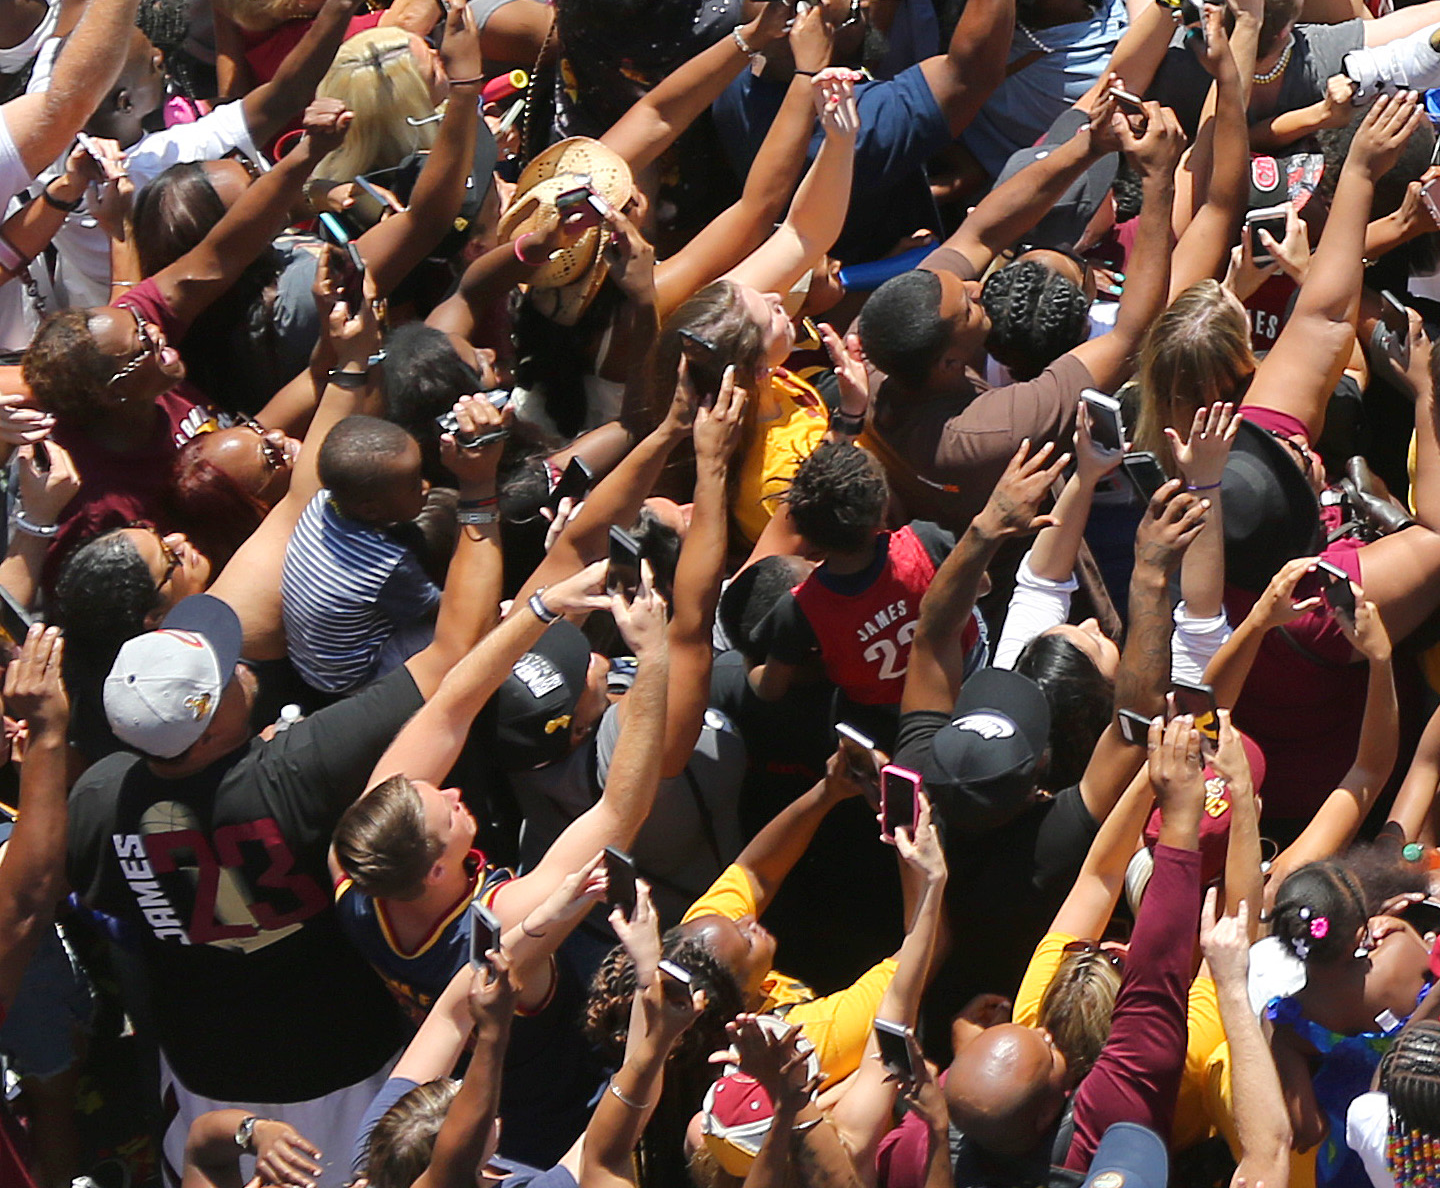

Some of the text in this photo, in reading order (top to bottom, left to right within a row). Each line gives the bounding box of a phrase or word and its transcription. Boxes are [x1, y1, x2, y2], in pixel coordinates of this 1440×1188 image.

[856, 598, 908, 643] JAMES
[112, 833, 191, 947] JAMES
[141, 816, 329, 946] 23
